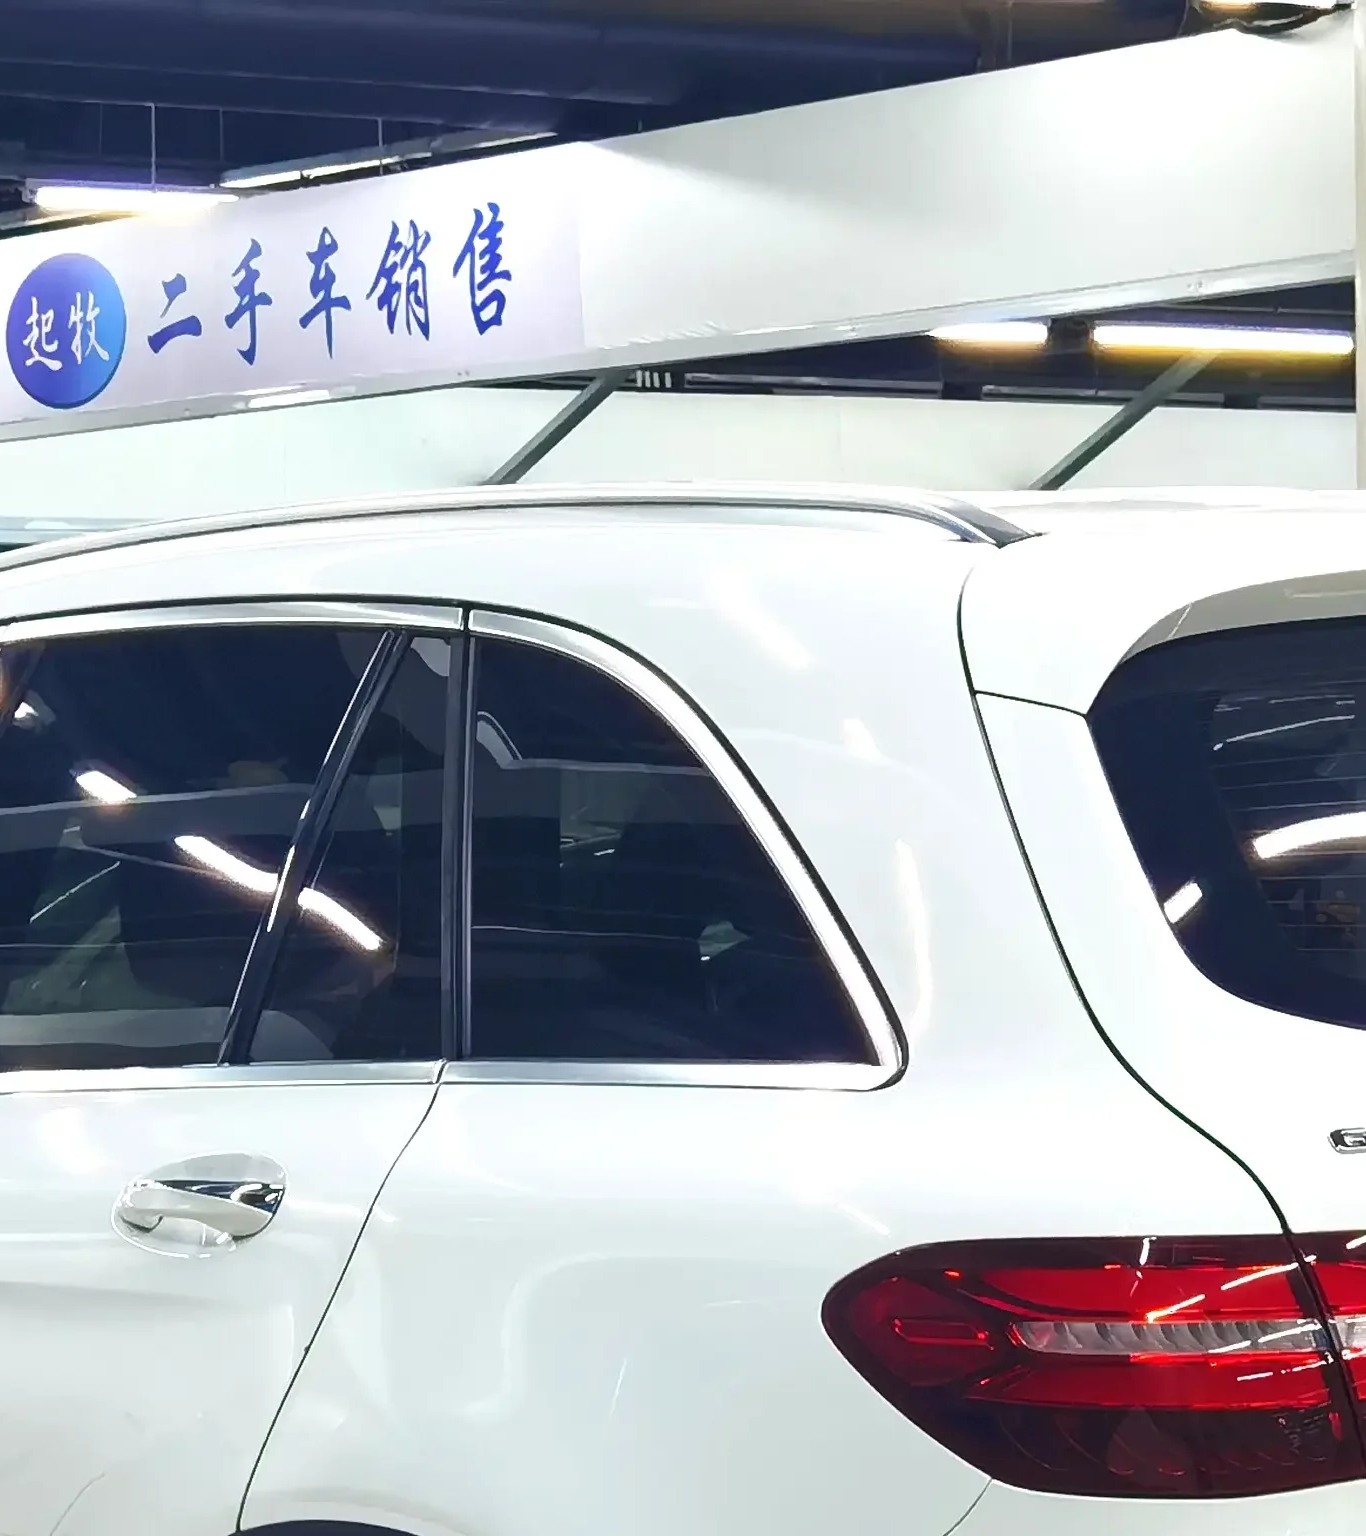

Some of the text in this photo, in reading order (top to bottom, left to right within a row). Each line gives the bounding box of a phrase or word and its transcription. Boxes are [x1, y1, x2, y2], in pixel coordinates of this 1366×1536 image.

[22, 290, 110, 372] 起牧
[147, 201, 513, 366] 二手车销售
